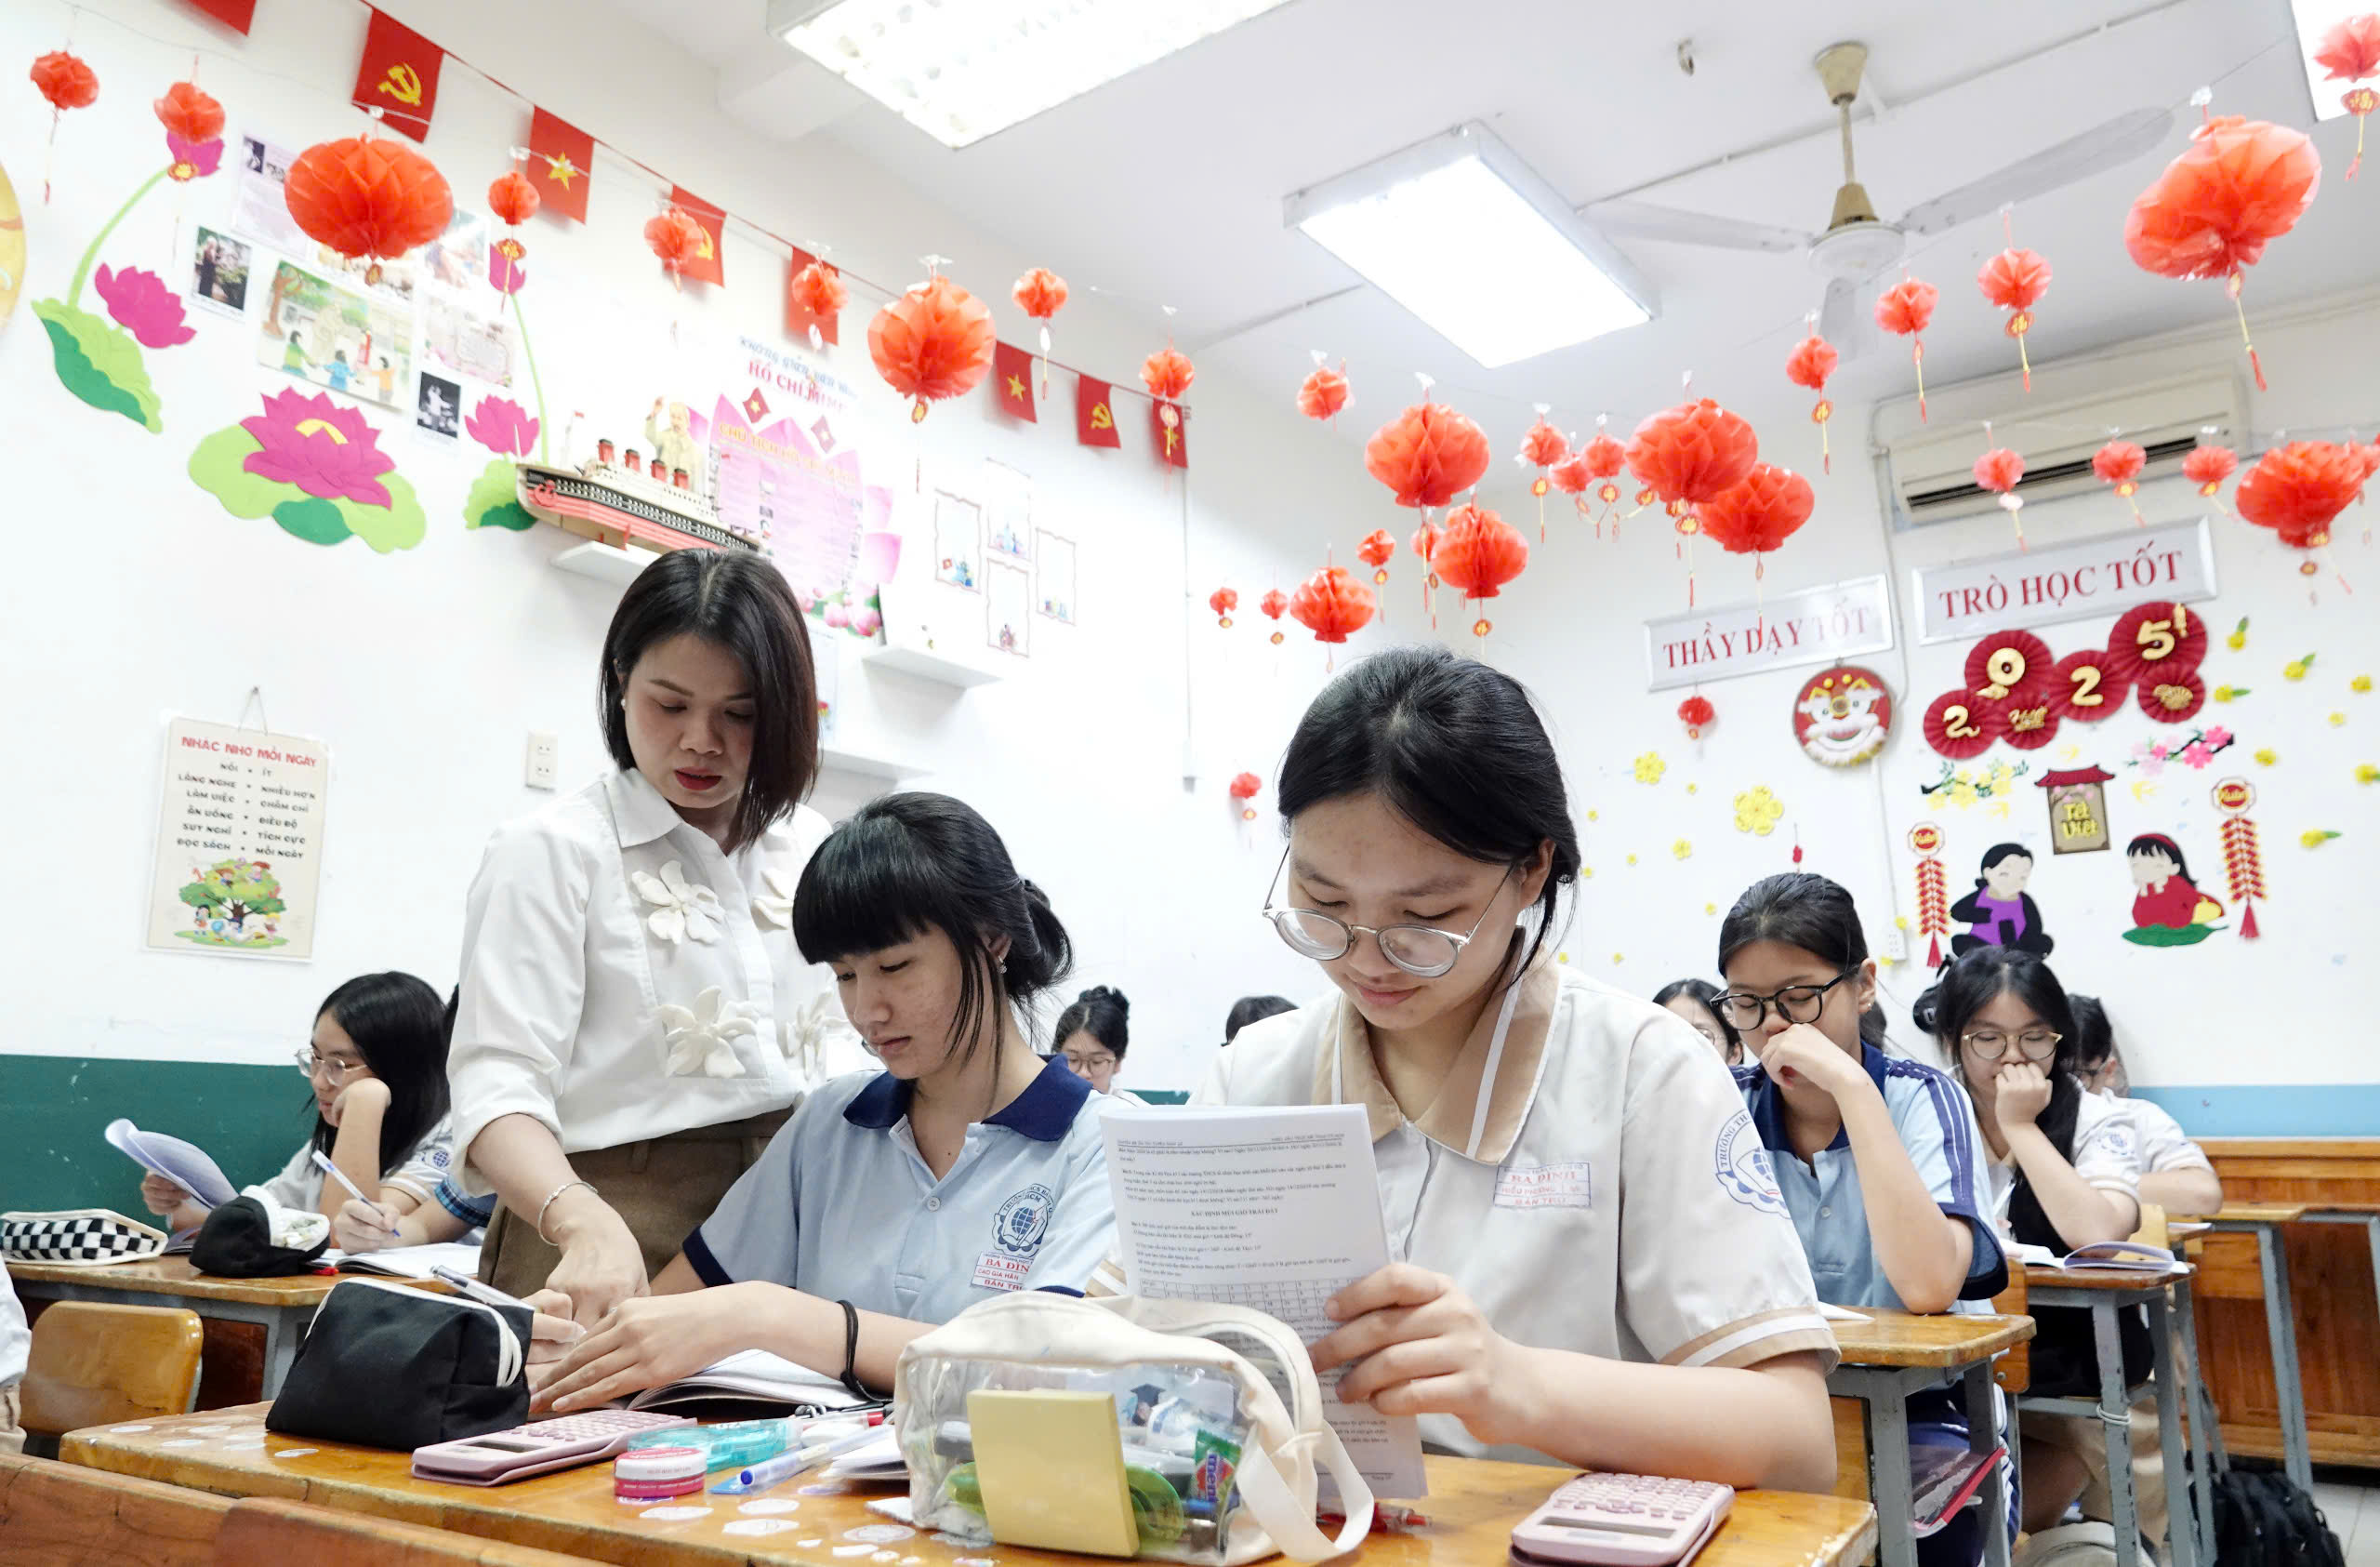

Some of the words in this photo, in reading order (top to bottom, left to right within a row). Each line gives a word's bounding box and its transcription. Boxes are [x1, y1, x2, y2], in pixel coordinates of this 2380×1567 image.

[1938, 574, 2008, 618] TRÒ
[2020, 565, 2097, 607] HỌC
[2106, 540, 2182, 591] TỐT
[1663, 621, 1736, 669] THẦY
[1745, 618, 1803, 656] DẠY
[1812, 596, 1870, 642] TỐT
[985, 1258, 1001, 1268] BA
[1005, 1261, 1031, 1273] ĐÌN
